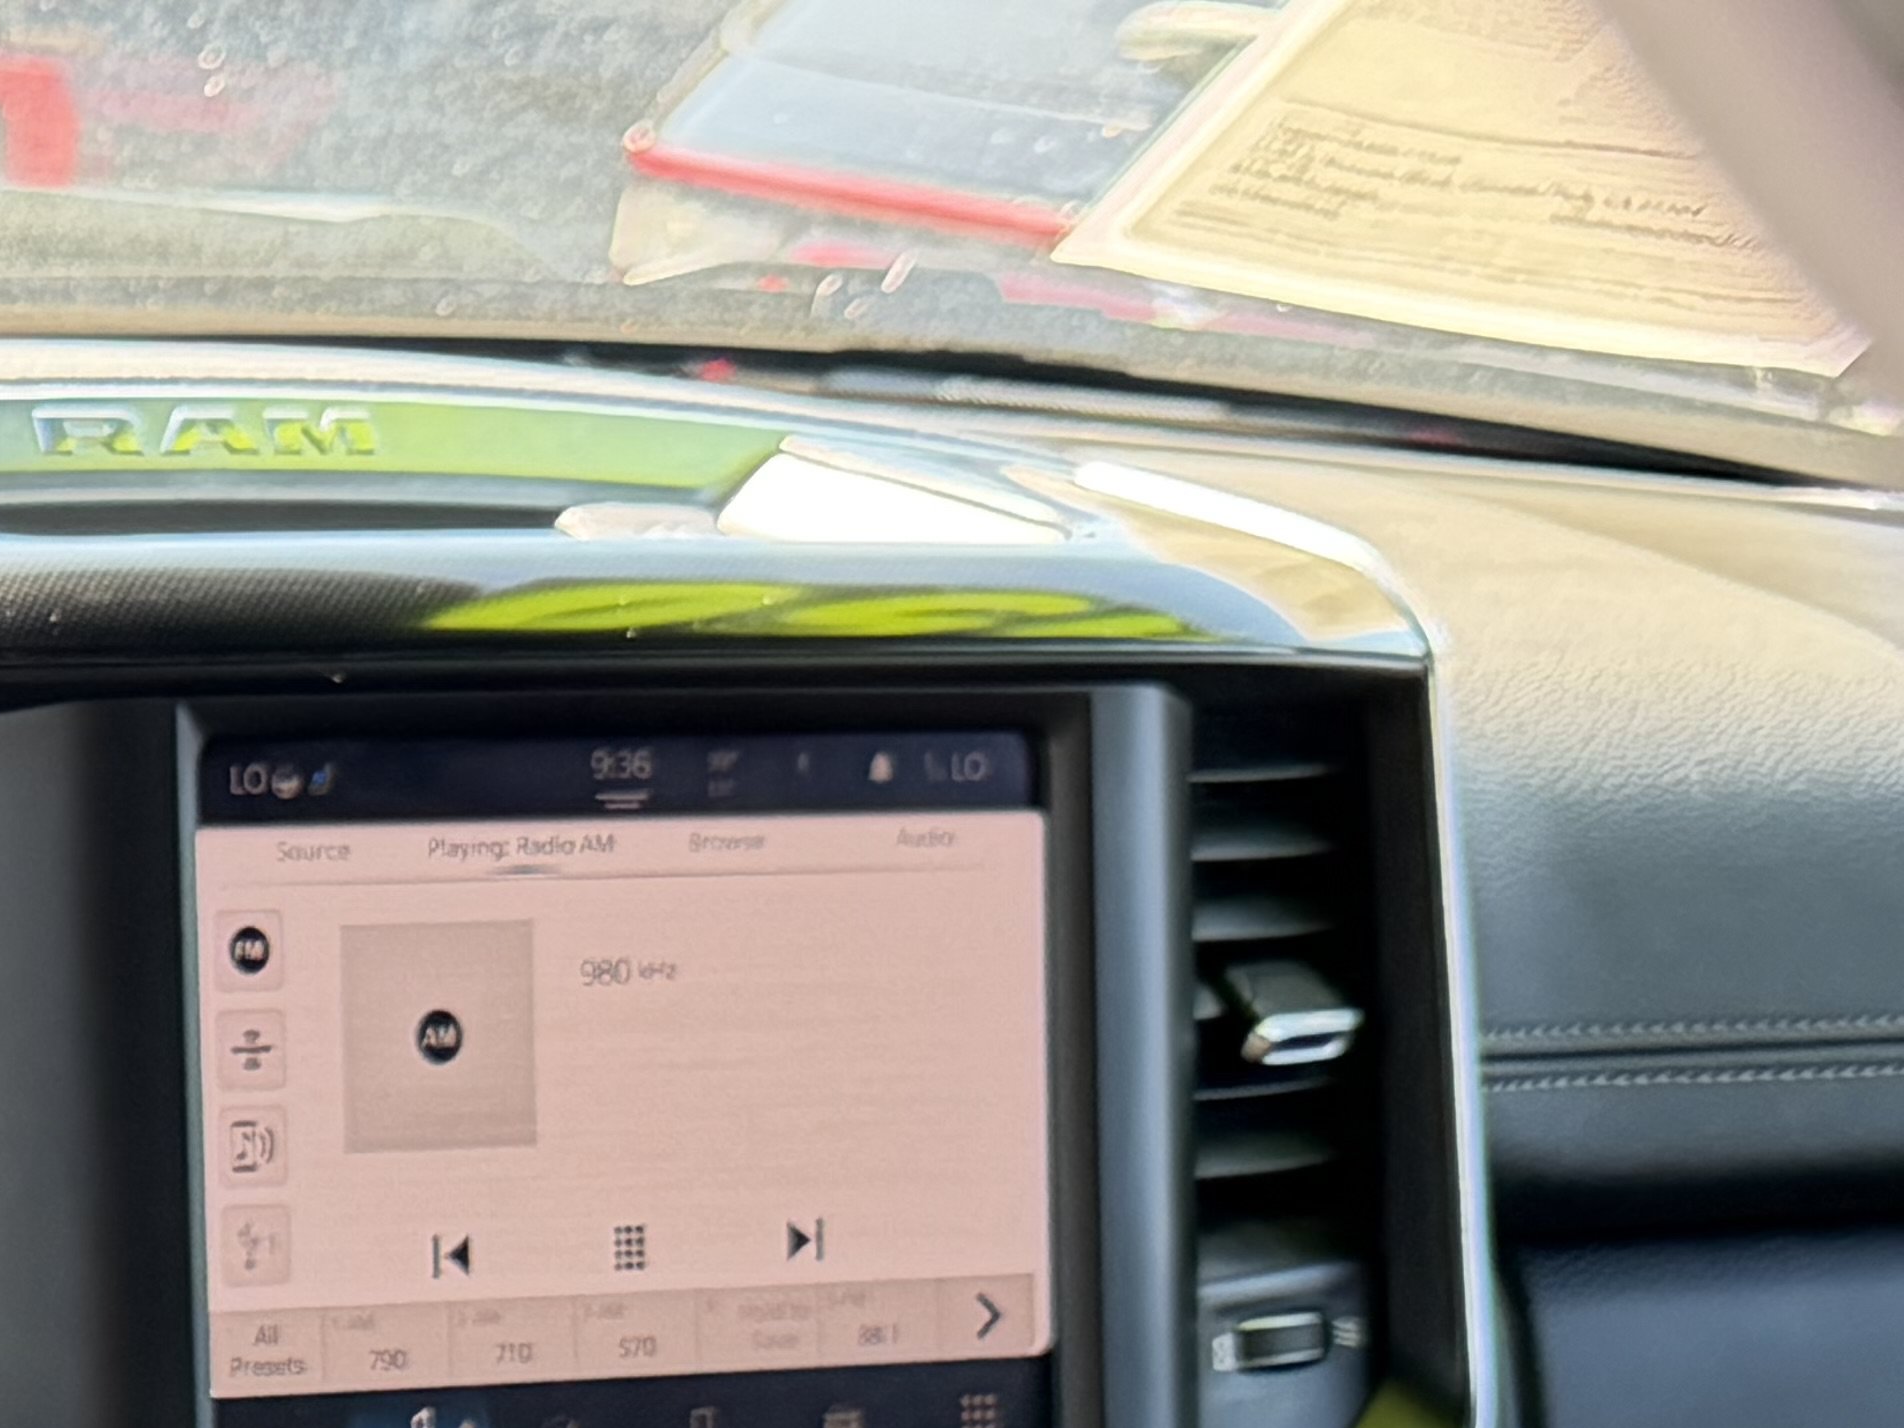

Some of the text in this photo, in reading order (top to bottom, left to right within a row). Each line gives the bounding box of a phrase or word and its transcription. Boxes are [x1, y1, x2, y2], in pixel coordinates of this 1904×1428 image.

[31, 406, 376, 456] RAM
[591, 749, 652, 780] 9:36
[951, 750, 988, 783] LO
[230, 763, 267, 796] LO
[276, 840, 351, 862] Source
[428, 834, 616, 858] Playing: Radio AM
[689, 833, 765, 852] Browse
[580, 958, 633, 987] 980
[252, 1324, 279, 1347] All
[619, 1334, 657, 1359] 570
[369, 1349, 409, 1372] 790
[496, 1341, 533, 1365] 710
[229, 1356, 307, 1378] Presets
